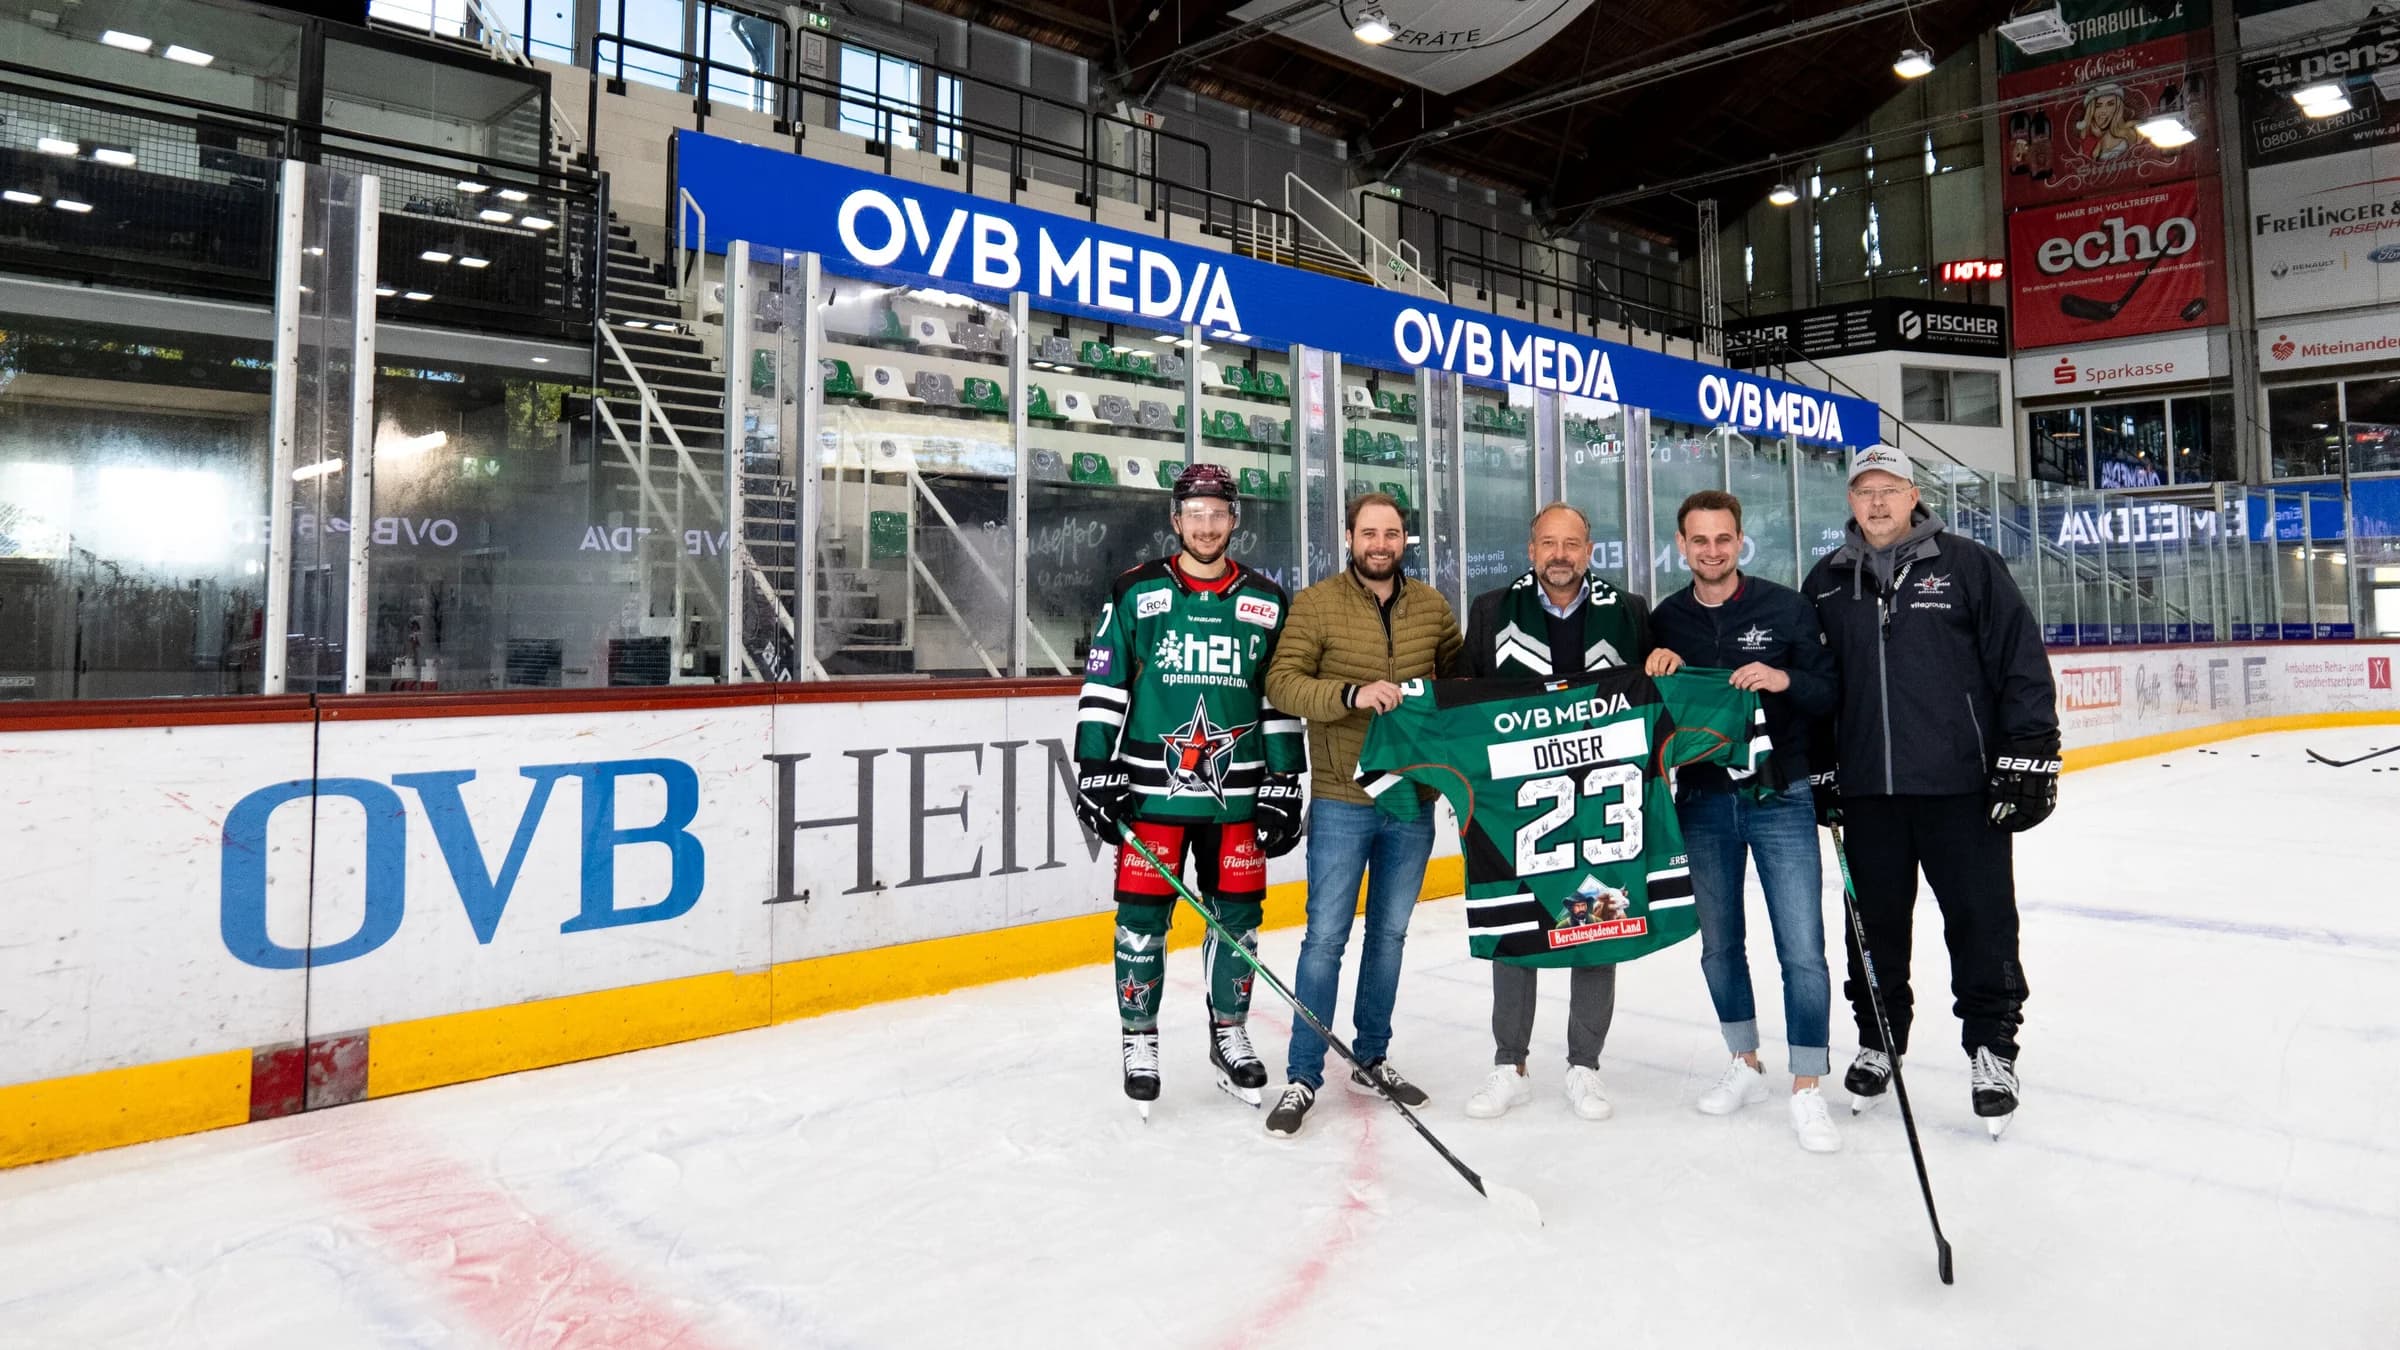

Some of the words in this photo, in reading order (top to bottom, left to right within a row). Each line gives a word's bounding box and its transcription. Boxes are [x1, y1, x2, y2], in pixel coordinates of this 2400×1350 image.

[2305, 107, 2372, 135] XLPRINT
[2056, 207, 2085, 220] IMMER
[2088, 205, 2103, 216] EIN
[2105, 193, 2169, 212] VOLLTREFFER!
[838, 189, 1021, 289] OVB
[1040, 227, 1242, 332] MEDIA
[2037, 216, 2196, 274] echo
[1926, 313, 1998, 334] FISCHER
[1394, 308, 1494, 377] OVB
[1502, 329, 1618, 401] MEDIA
[2086, 361, 2175, 383] Sparkasse
[1699, 373, 1763, 425] OVB
[1766, 387, 1843, 442] MEDIA
[1494, 708, 1552, 734] OVB
[1556, 692, 1632, 726] MEDIA
[1533, 734, 1604, 770] DÖSER
[1514, 761, 1644, 878] 23
[220, 757, 705, 970] OVB
[1554, 925, 1619, 945] Berchtesgadener
[1620, 920, 1641, 934] Land
